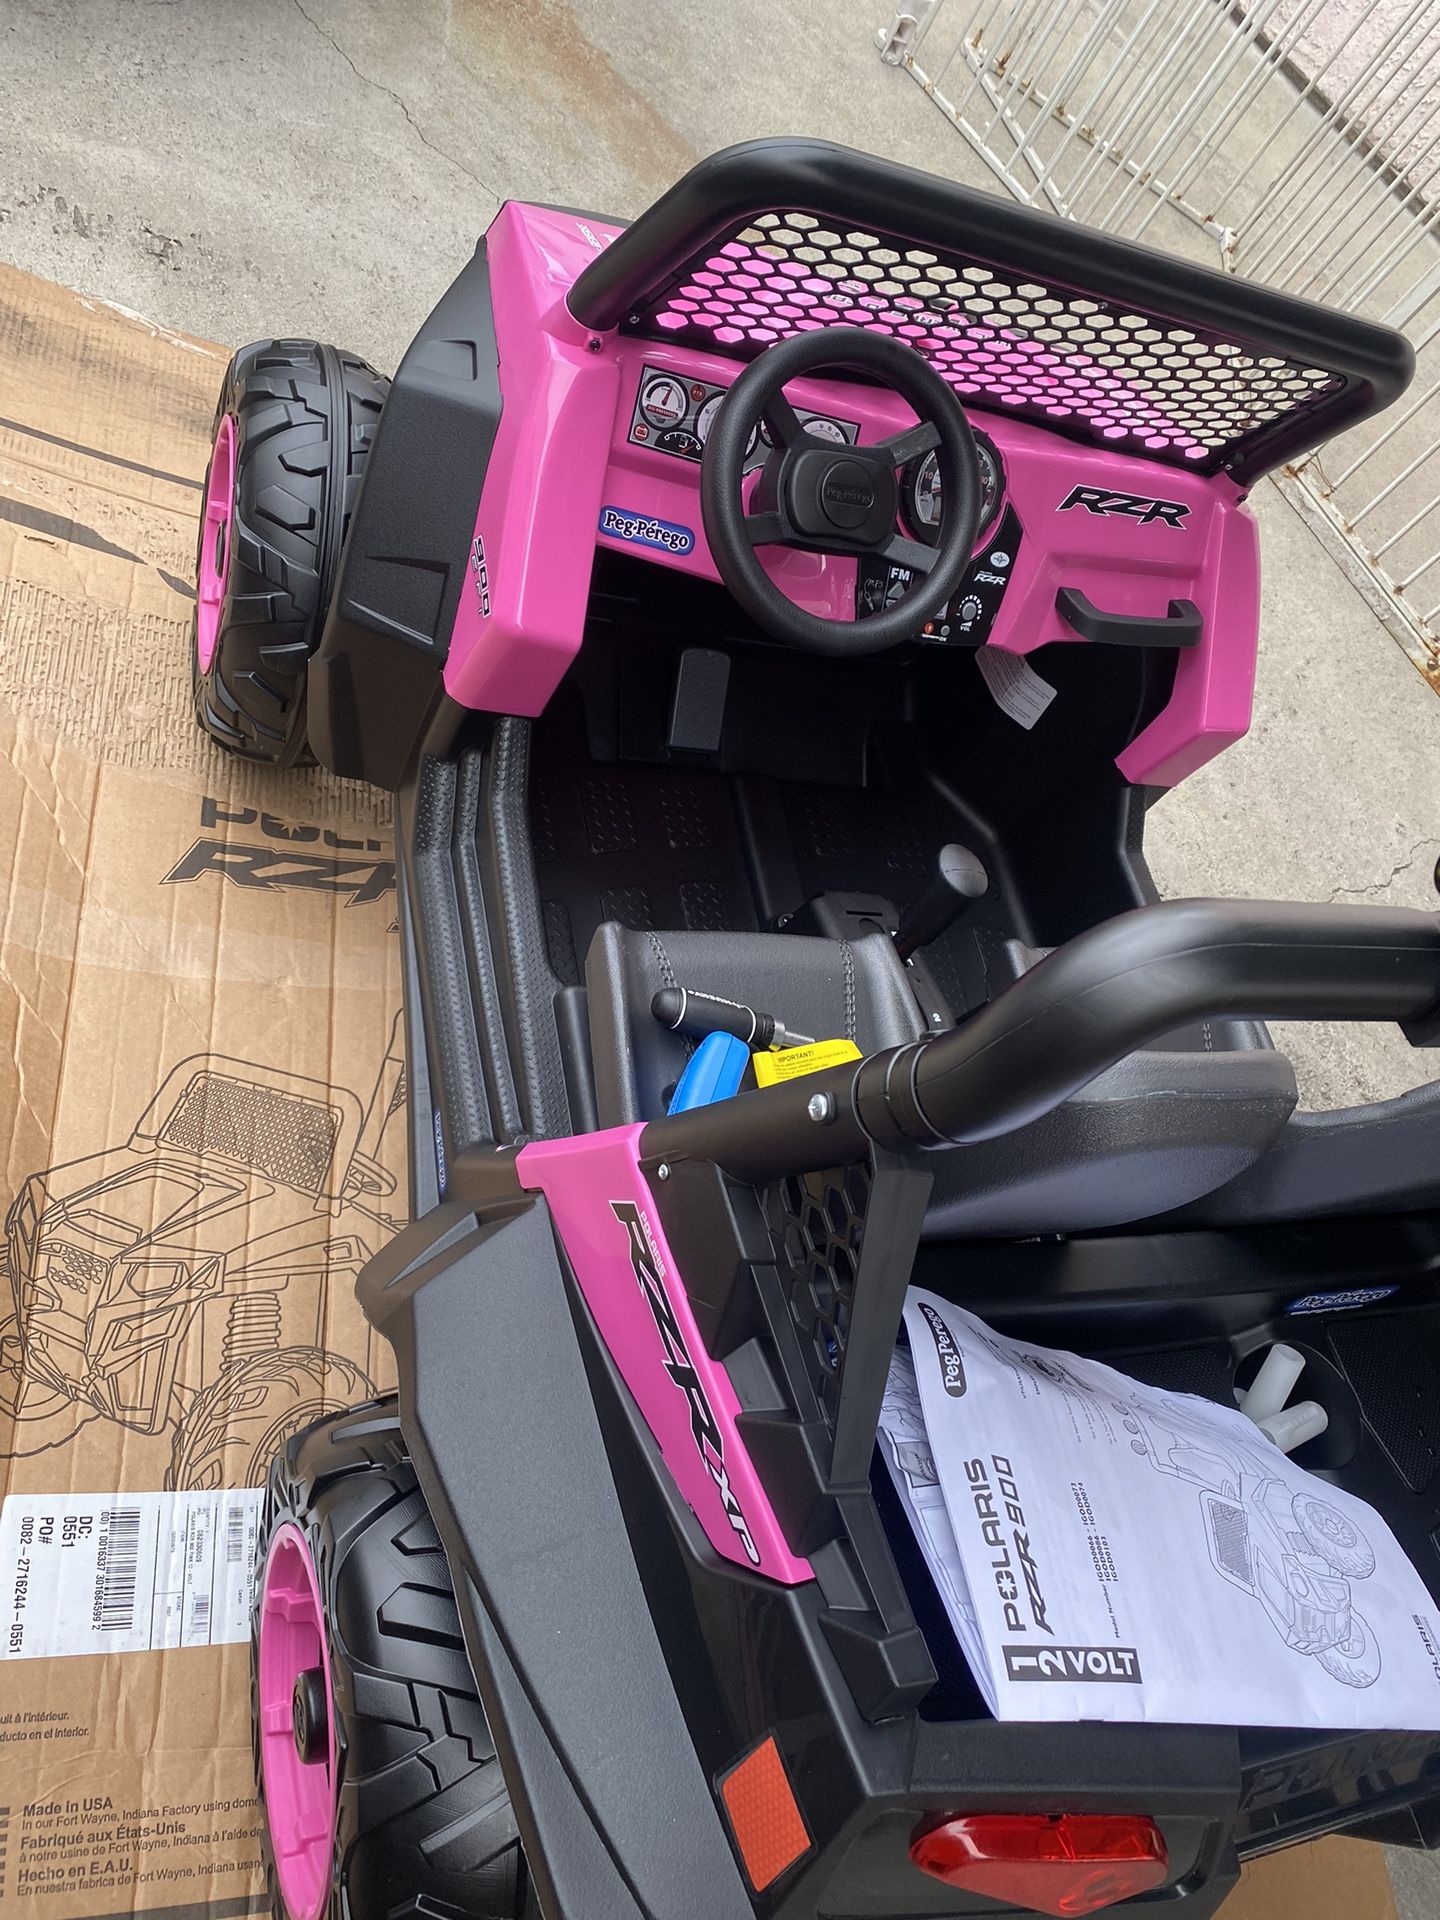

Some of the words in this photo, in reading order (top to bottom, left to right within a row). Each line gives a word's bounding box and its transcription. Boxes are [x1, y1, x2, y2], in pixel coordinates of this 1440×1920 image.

[1055, 484, 1192, 530] RZR
[473, 535, 491, 618] 900
[890, 567, 910, 582] FM
[974, 573, 1007, 586] RZR
[932, 1012, 941, 1022] 2
[640, 1210, 667, 1278] POLARIS
[608, 1200, 724, 1475] RZR
[708, 1463, 760, 1566] XP
[991, 1454, 1026, 1528] 900
[38, 1517, 54, 1544] PO#
[61, 1516, 77, 1548] 0551
[78, 1516, 93, 1540] DC:
[96, 1535, 107, 1571] 0016337
[963, 1458, 1027, 1632] POLARIS
[1102, 1536, 1118, 1582] IGOD0103
[92, 1574, 105, 1622] 301684599
[1012, 1528, 1056, 1636] RZR
[1102, 1584, 1114, 1613] Number
[1110, 1614, 1120, 1638] Model
[1010, 1650, 1068, 1676] 12
[1066, 1650, 1135, 1676] VOLT
[1412, 1614, 1440, 1684] OLARIS
[29, 1731, 42, 1740] en
[44, 1728, 53, 1739] el
[22, 1820, 32, 1830] In
[35, 1820, 53, 1830] our
[56, 1816, 78, 1827] Fort
[79, 1813, 120, 1827] Wayne,
[123, 1808, 159, 1820] Indiana
[162, 1804, 201, 1817] Factory
[203, 1801, 230, 1812] using
[23, 1802, 61, 1817] Made
[66, 1800, 78, 1813] in
[83, 1797, 113, 1811] USA
[19, 1852, 26, 1863] à
[30, 1850, 57, 1862] notre
[60, 1847, 89, 1860] usine
[92, 1845, 105, 1856] de
[108, 1841, 130, 1854] Fort
[132, 1839, 170, 1852] Wayne,
[173, 1836, 210, 1847] Indiana
[213, 1832, 219, 1842] à
[222, 1829, 248, 1841] l'aide
[20, 1832, 84, 1850] Fabriqué
[88, 1830, 112, 1843] aux
[117, 1822, 186, 1839] États-Unis
[17, 1884, 30, 1896] En
[35, 1882, 76, 1895] nuestra
[79, 1877, 114, 1890] fabrica
[117, 1874, 130, 1885] de
[133, 1872, 154, 1884] Fort
[157, 1869, 195, 1881] Wayne,
[198, 1863, 234, 1875] Indiana
[18, 1866, 65, 1882] Hecho
[68, 1866, 86, 1877] en
[90, 1858, 134, 1875] E.A.U.
